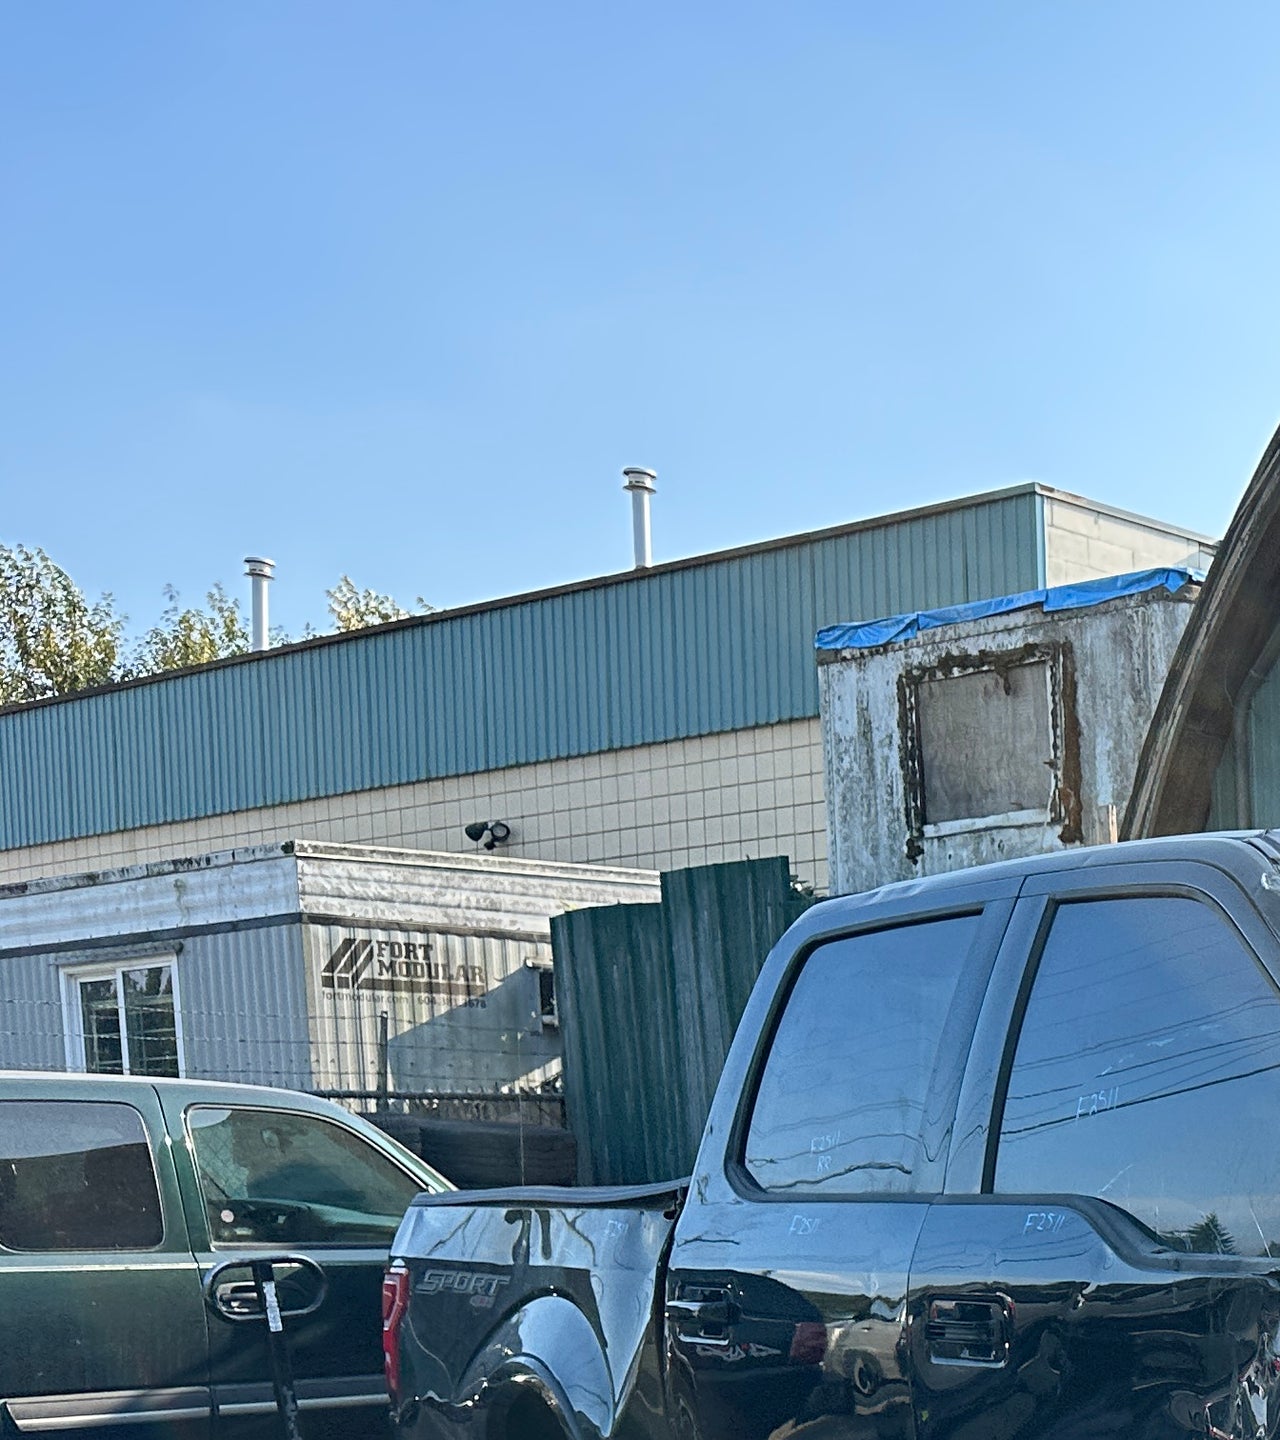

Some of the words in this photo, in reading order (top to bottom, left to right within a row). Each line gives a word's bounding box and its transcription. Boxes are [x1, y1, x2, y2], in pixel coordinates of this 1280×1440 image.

[375, 940, 434, 961] FORT
[377, 959, 486, 983] MODULAR
[414, 1268, 512, 1296] SPORT
